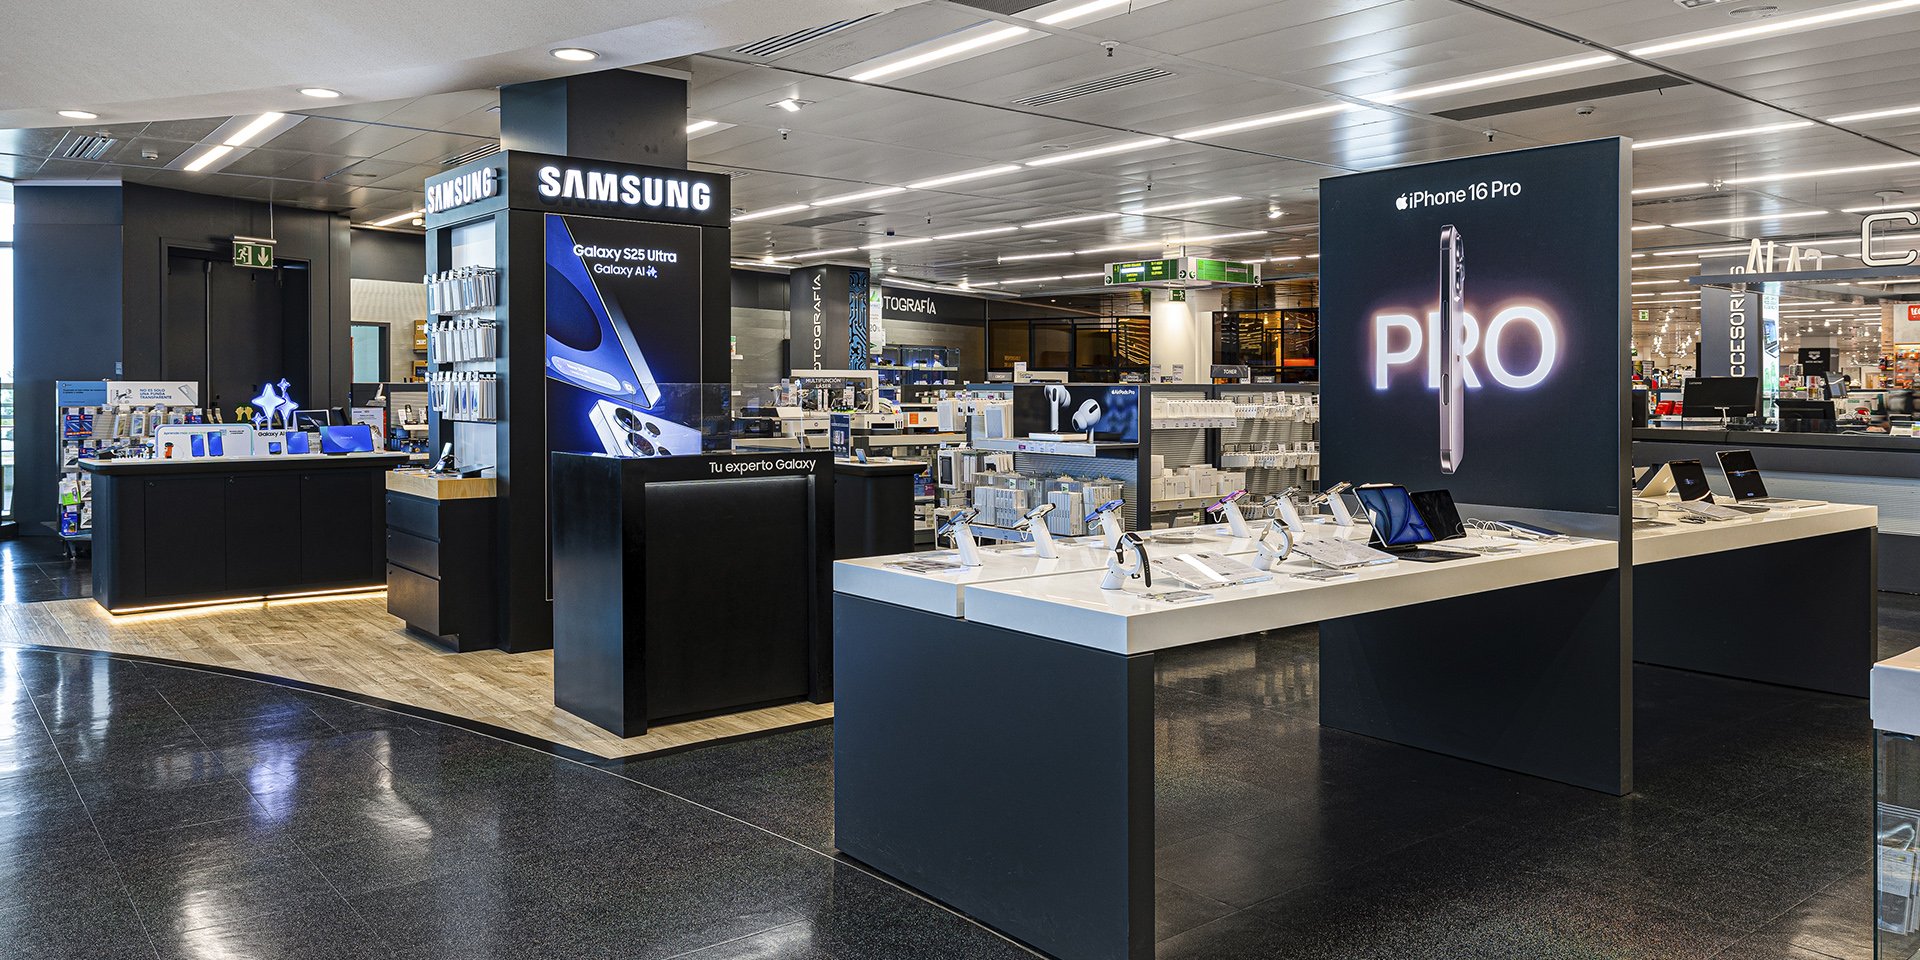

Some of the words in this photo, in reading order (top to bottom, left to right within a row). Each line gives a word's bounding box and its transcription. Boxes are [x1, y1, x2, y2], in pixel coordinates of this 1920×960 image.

[427, 167, 497, 214] SAMSUNG
[538, 165, 711, 211] SAMSUNG
[1409, 189, 1467, 209] iPhone
[1468, 182, 1489, 201] 16
[1491, 180, 1522, 198] Pro
[573, 244, 622, 262] Galaxy
[623, 247, 646, 261] S25
[647, 249, 677, 263] Ultra
[593, 263, 633, 278] Galaxy
[634, 266, 645, 277] AI
[882, 296, 937, 315] TOGRAFÍA
[811, 274, 822, 370] OTOGRAFÍA
[1376, 306, 1556, 389] PRO
[709, 461, 723, 473] Tu
[725, 460, 774, 475] experto
[775, 458, 816, 472] Galaxy
